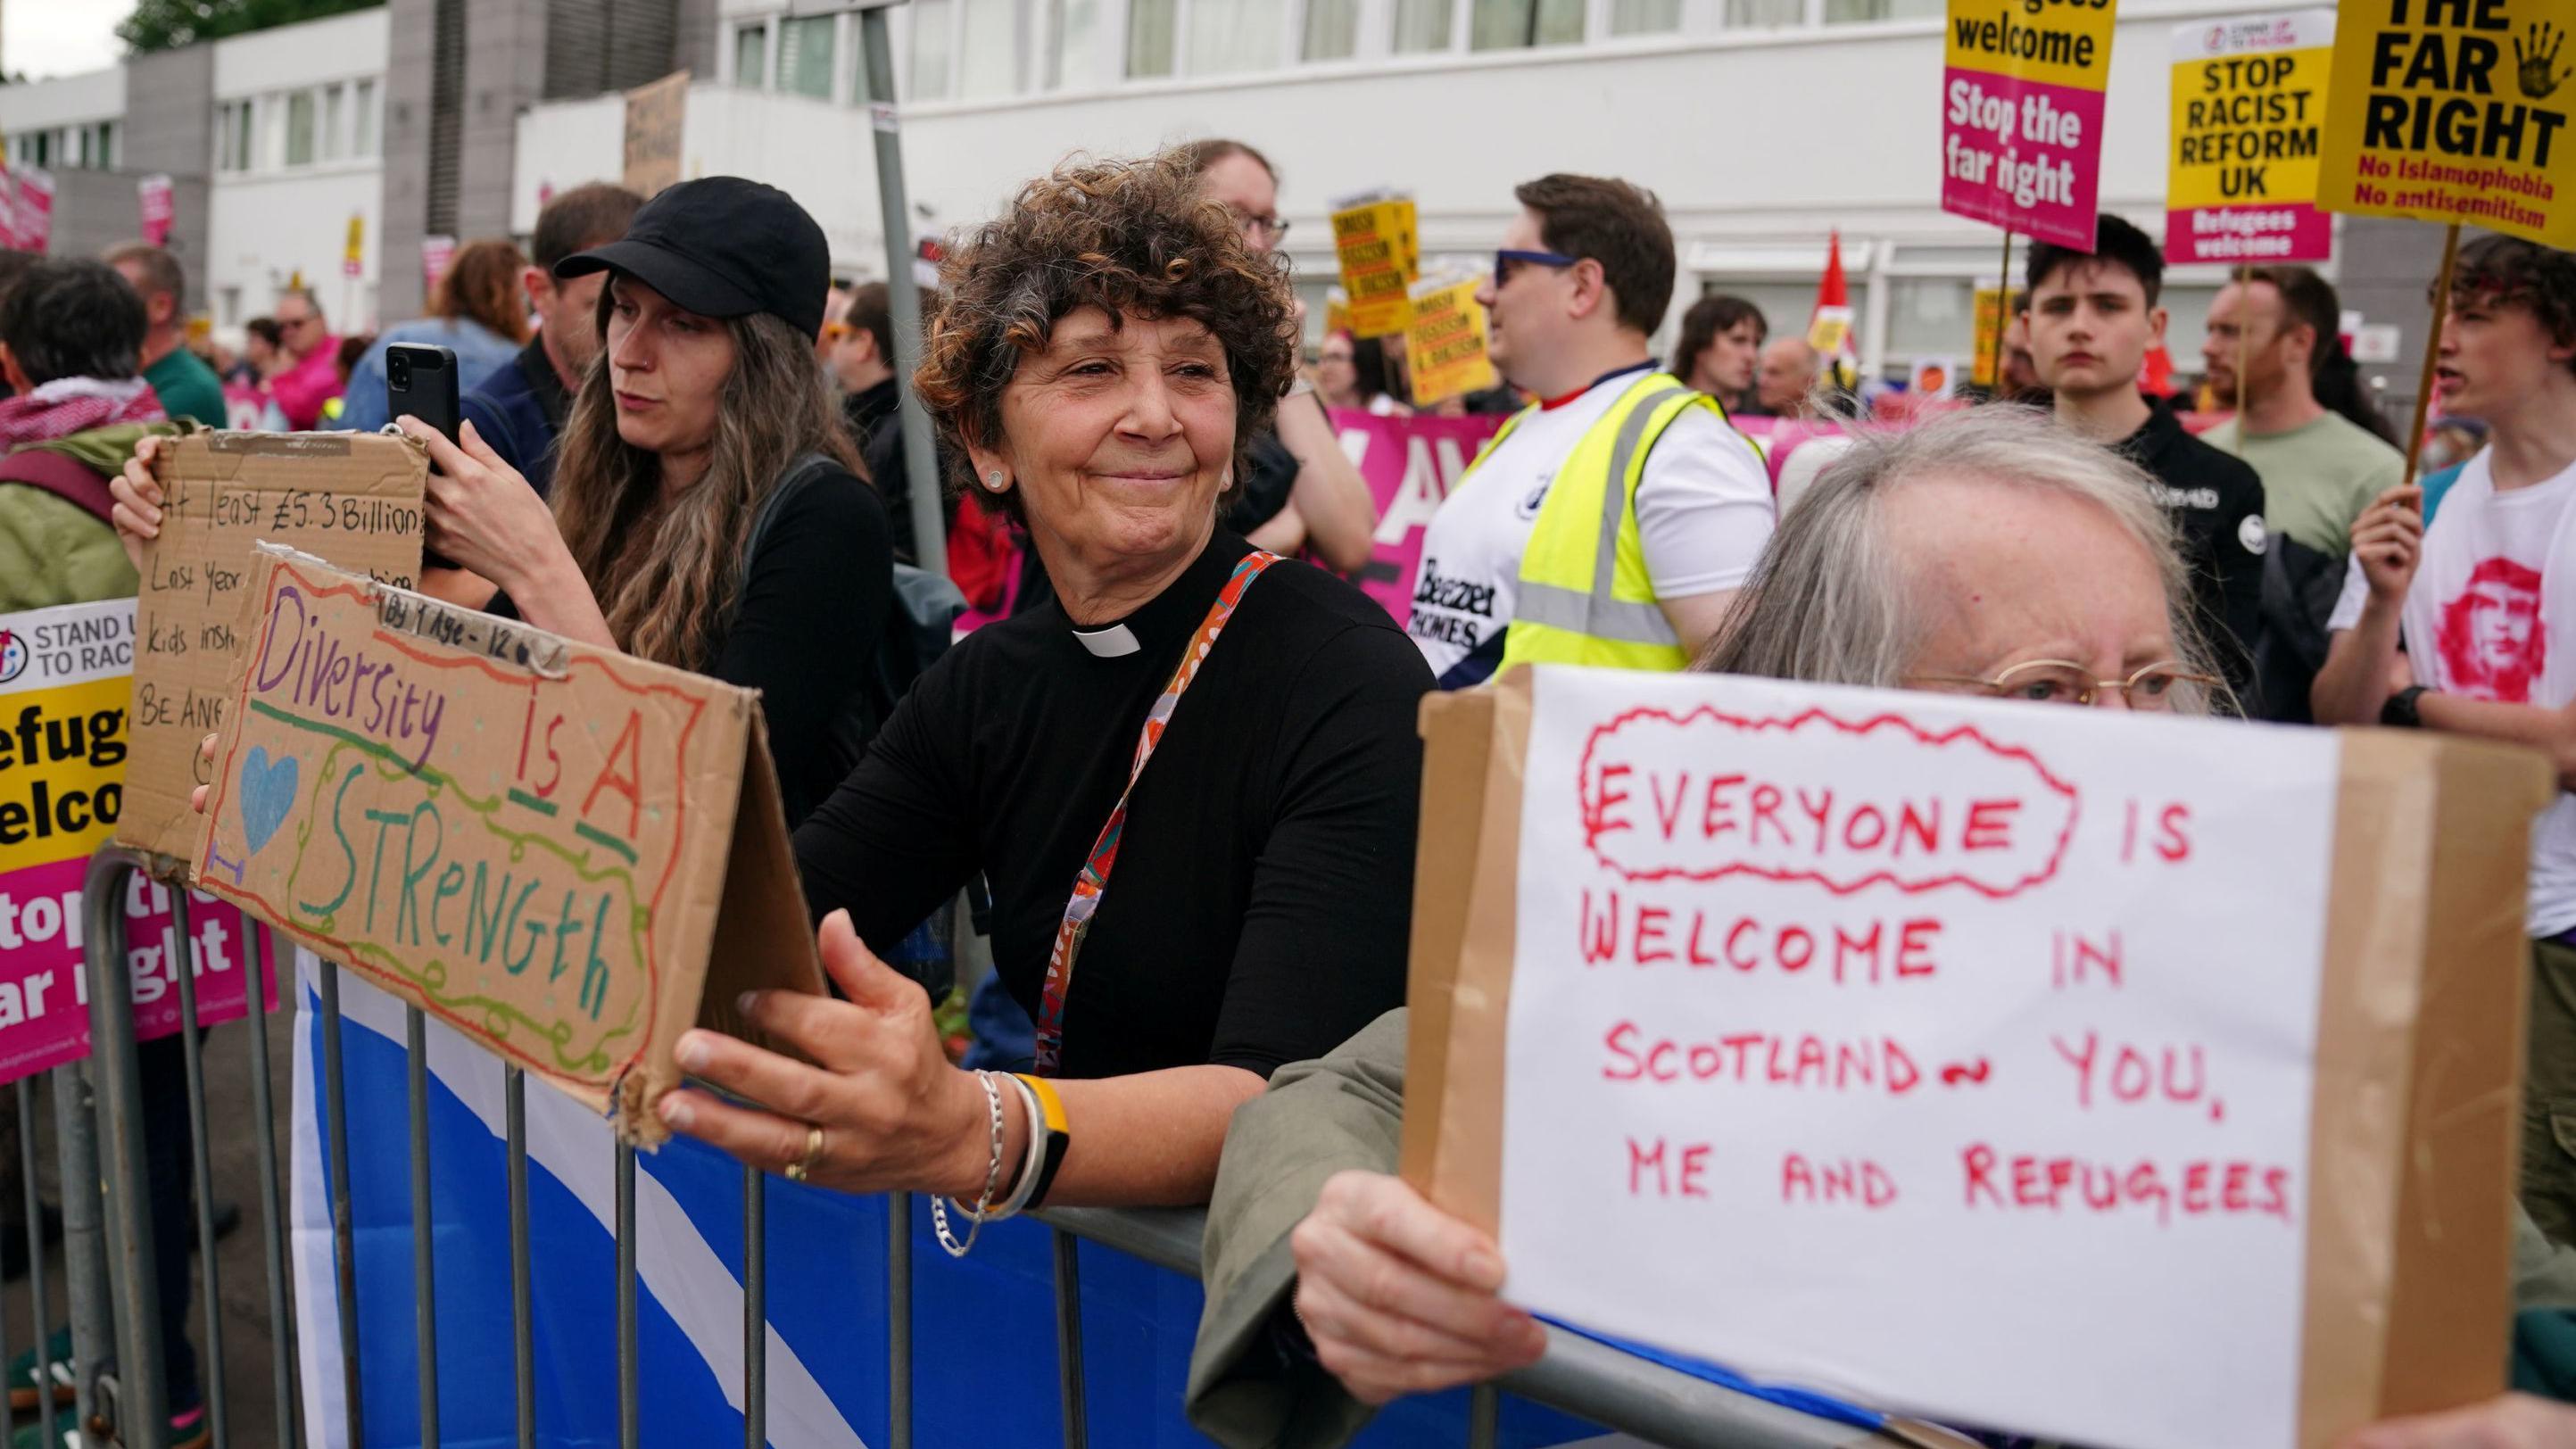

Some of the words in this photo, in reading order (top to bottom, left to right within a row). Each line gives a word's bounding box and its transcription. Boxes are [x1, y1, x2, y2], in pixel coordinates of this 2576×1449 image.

[1956, 11, 2094, 67] welcome
[2372, 32, 2499, 95] FAR
[2204, 57, 2295, 92] STOP
[1949, 79, 2017, 145] Stop
[2022, 94, 2082, 149] the
[2189, 91, 2312, 128] RACIST
[2364, 94, 2566, 168] RIGHT
[1947, 133, 1993, 185] far
[1997, 147, 2075, 208] right
[2181, 127, 2318, 165] REFORM
[2220, 167, 2267, 197] UK
[2358, 154, 2391, 178] No
[2398, 158, 2554, 201] Islamophobia
[2192, 208, 2296, 236] Refugees
[2354, 183, 2388, 206] No
[2395, 188, 2546, 229] antisemitism
[2193, 235, 2293, 258] welcome
[208, 481, 261, 530] least
[271, 487, 336, 533] £5.3
[36, 616, 120, 650] STAND
[37, 651, 72, 677] TO
[81, 640, 132, 671] RAC
[139, 683, 173, 726] BE
[581, 708, 642, 840] A
[0, 780, 123, 845] elco
[1588, 766, 2024, 858] EVERYONE
[2120, 801, 2192, 865] IS
[1580, 889, 1946, 985] WELCOME
[2051, 926, 2126, 992] IN
[0, 970, 54, 1029] ar
[1626, 1135, 1713, 1200] ME
[1783, 1151, 1898, 1210] AND
[1961, 1142, 2292, 1226] REFUGEES
